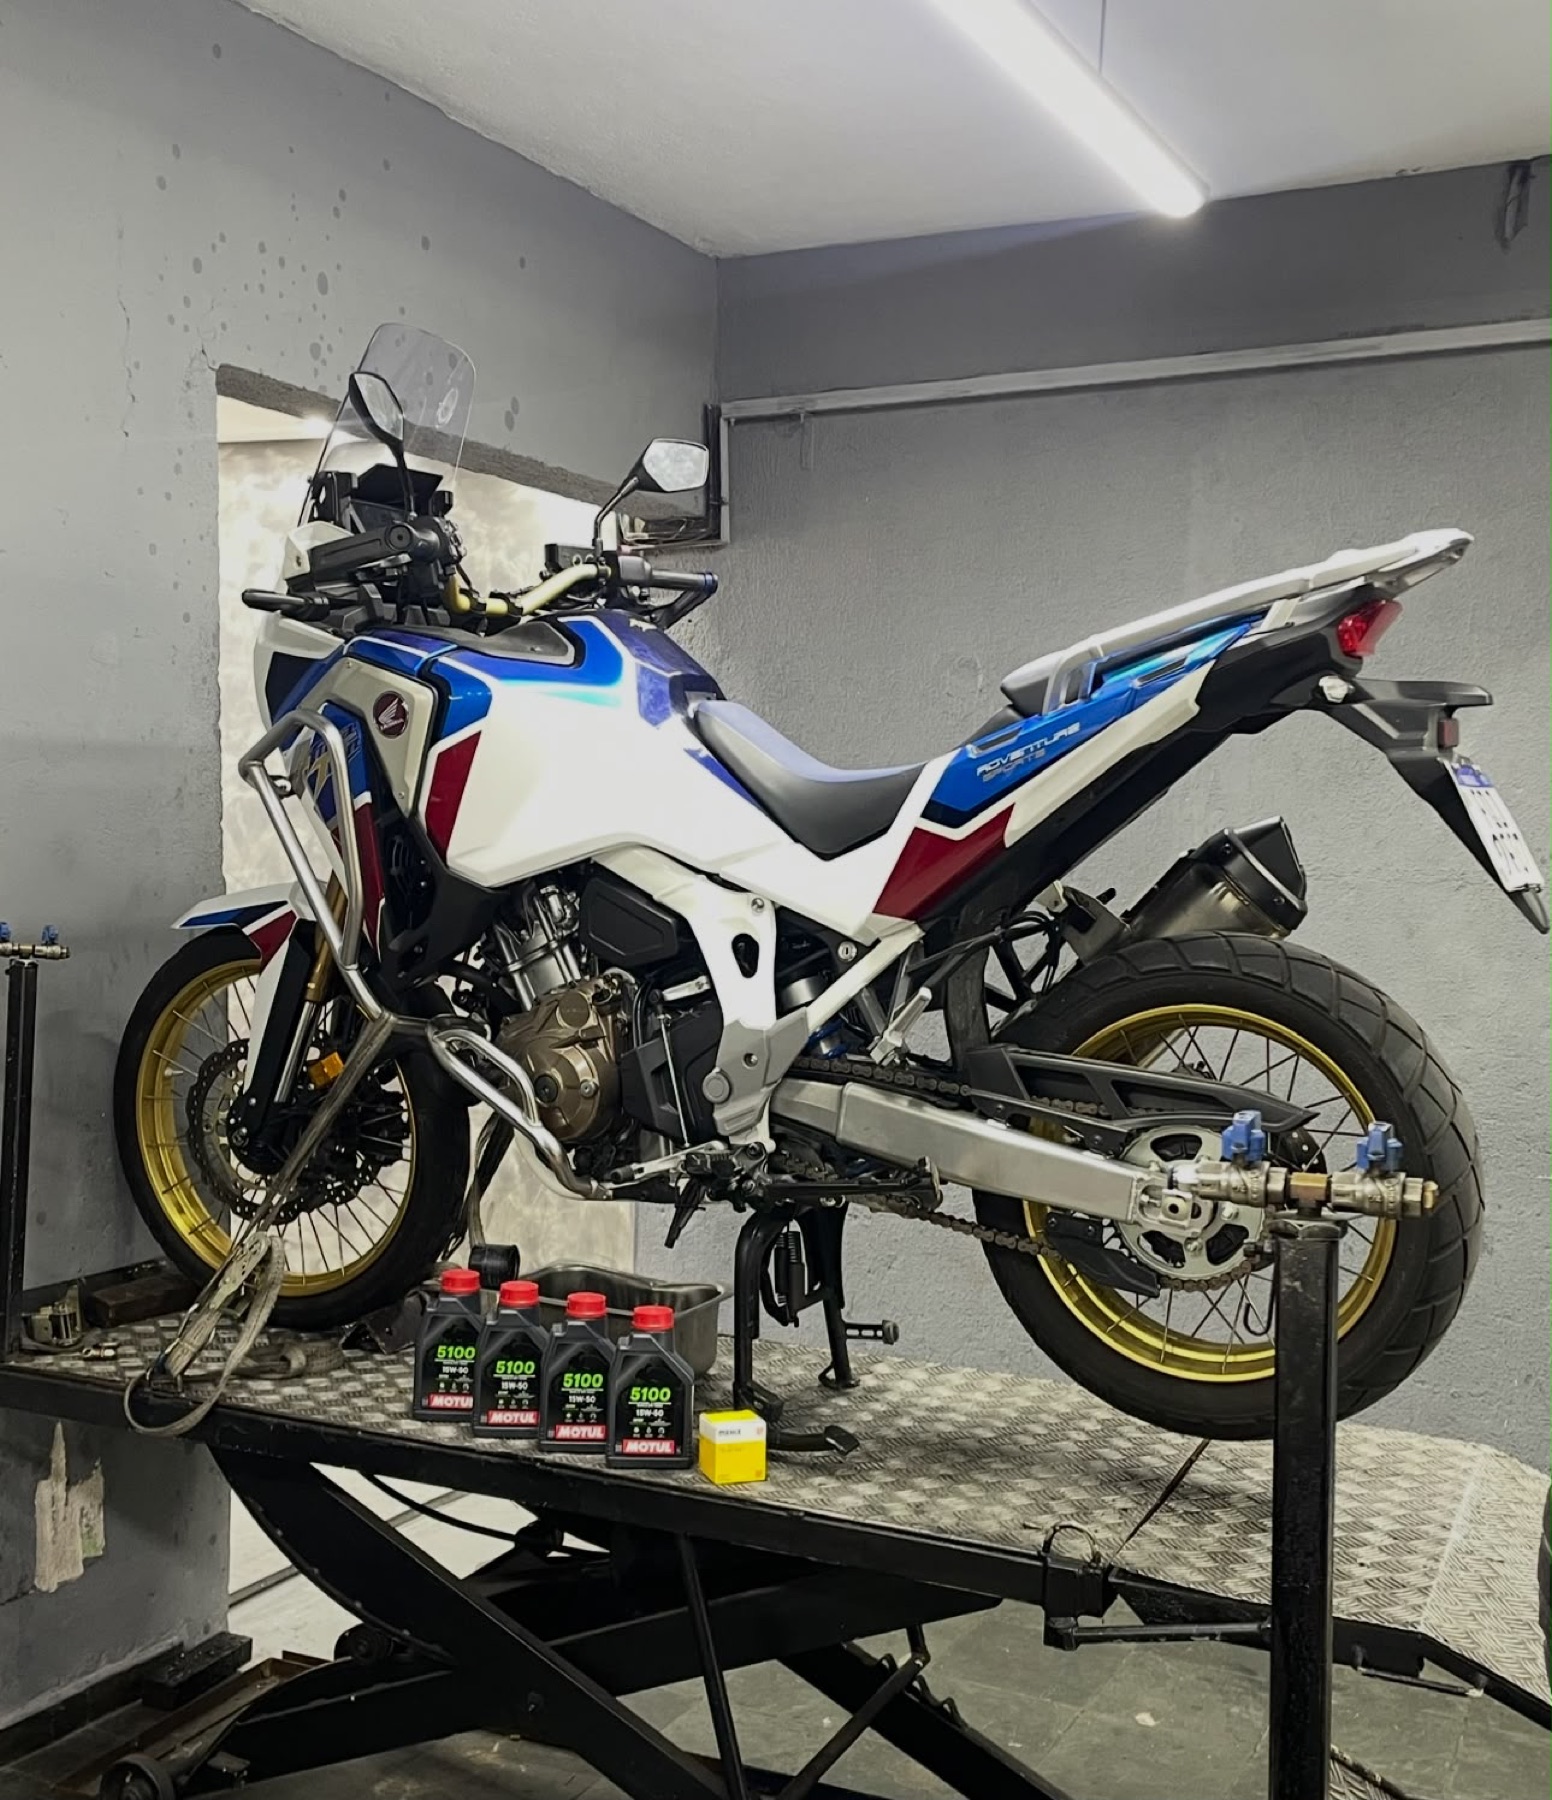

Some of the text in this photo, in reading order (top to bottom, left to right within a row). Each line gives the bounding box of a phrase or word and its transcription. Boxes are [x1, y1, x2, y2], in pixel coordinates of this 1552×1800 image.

[976, 722, 1080, 776] ADVENTURE
[437, 1345, 476, 1359] 5100
[495, 1360, 535, 1374] 5100
[563, 1373, 604, 1388] 5100
[629, 1386, 671, 1401] 5100
[488, 1411, 536, 1424] MOTUL
[557, 1425, 605, 1438] MOTUL
[625, 1440, 672, 1454] MOTUL
